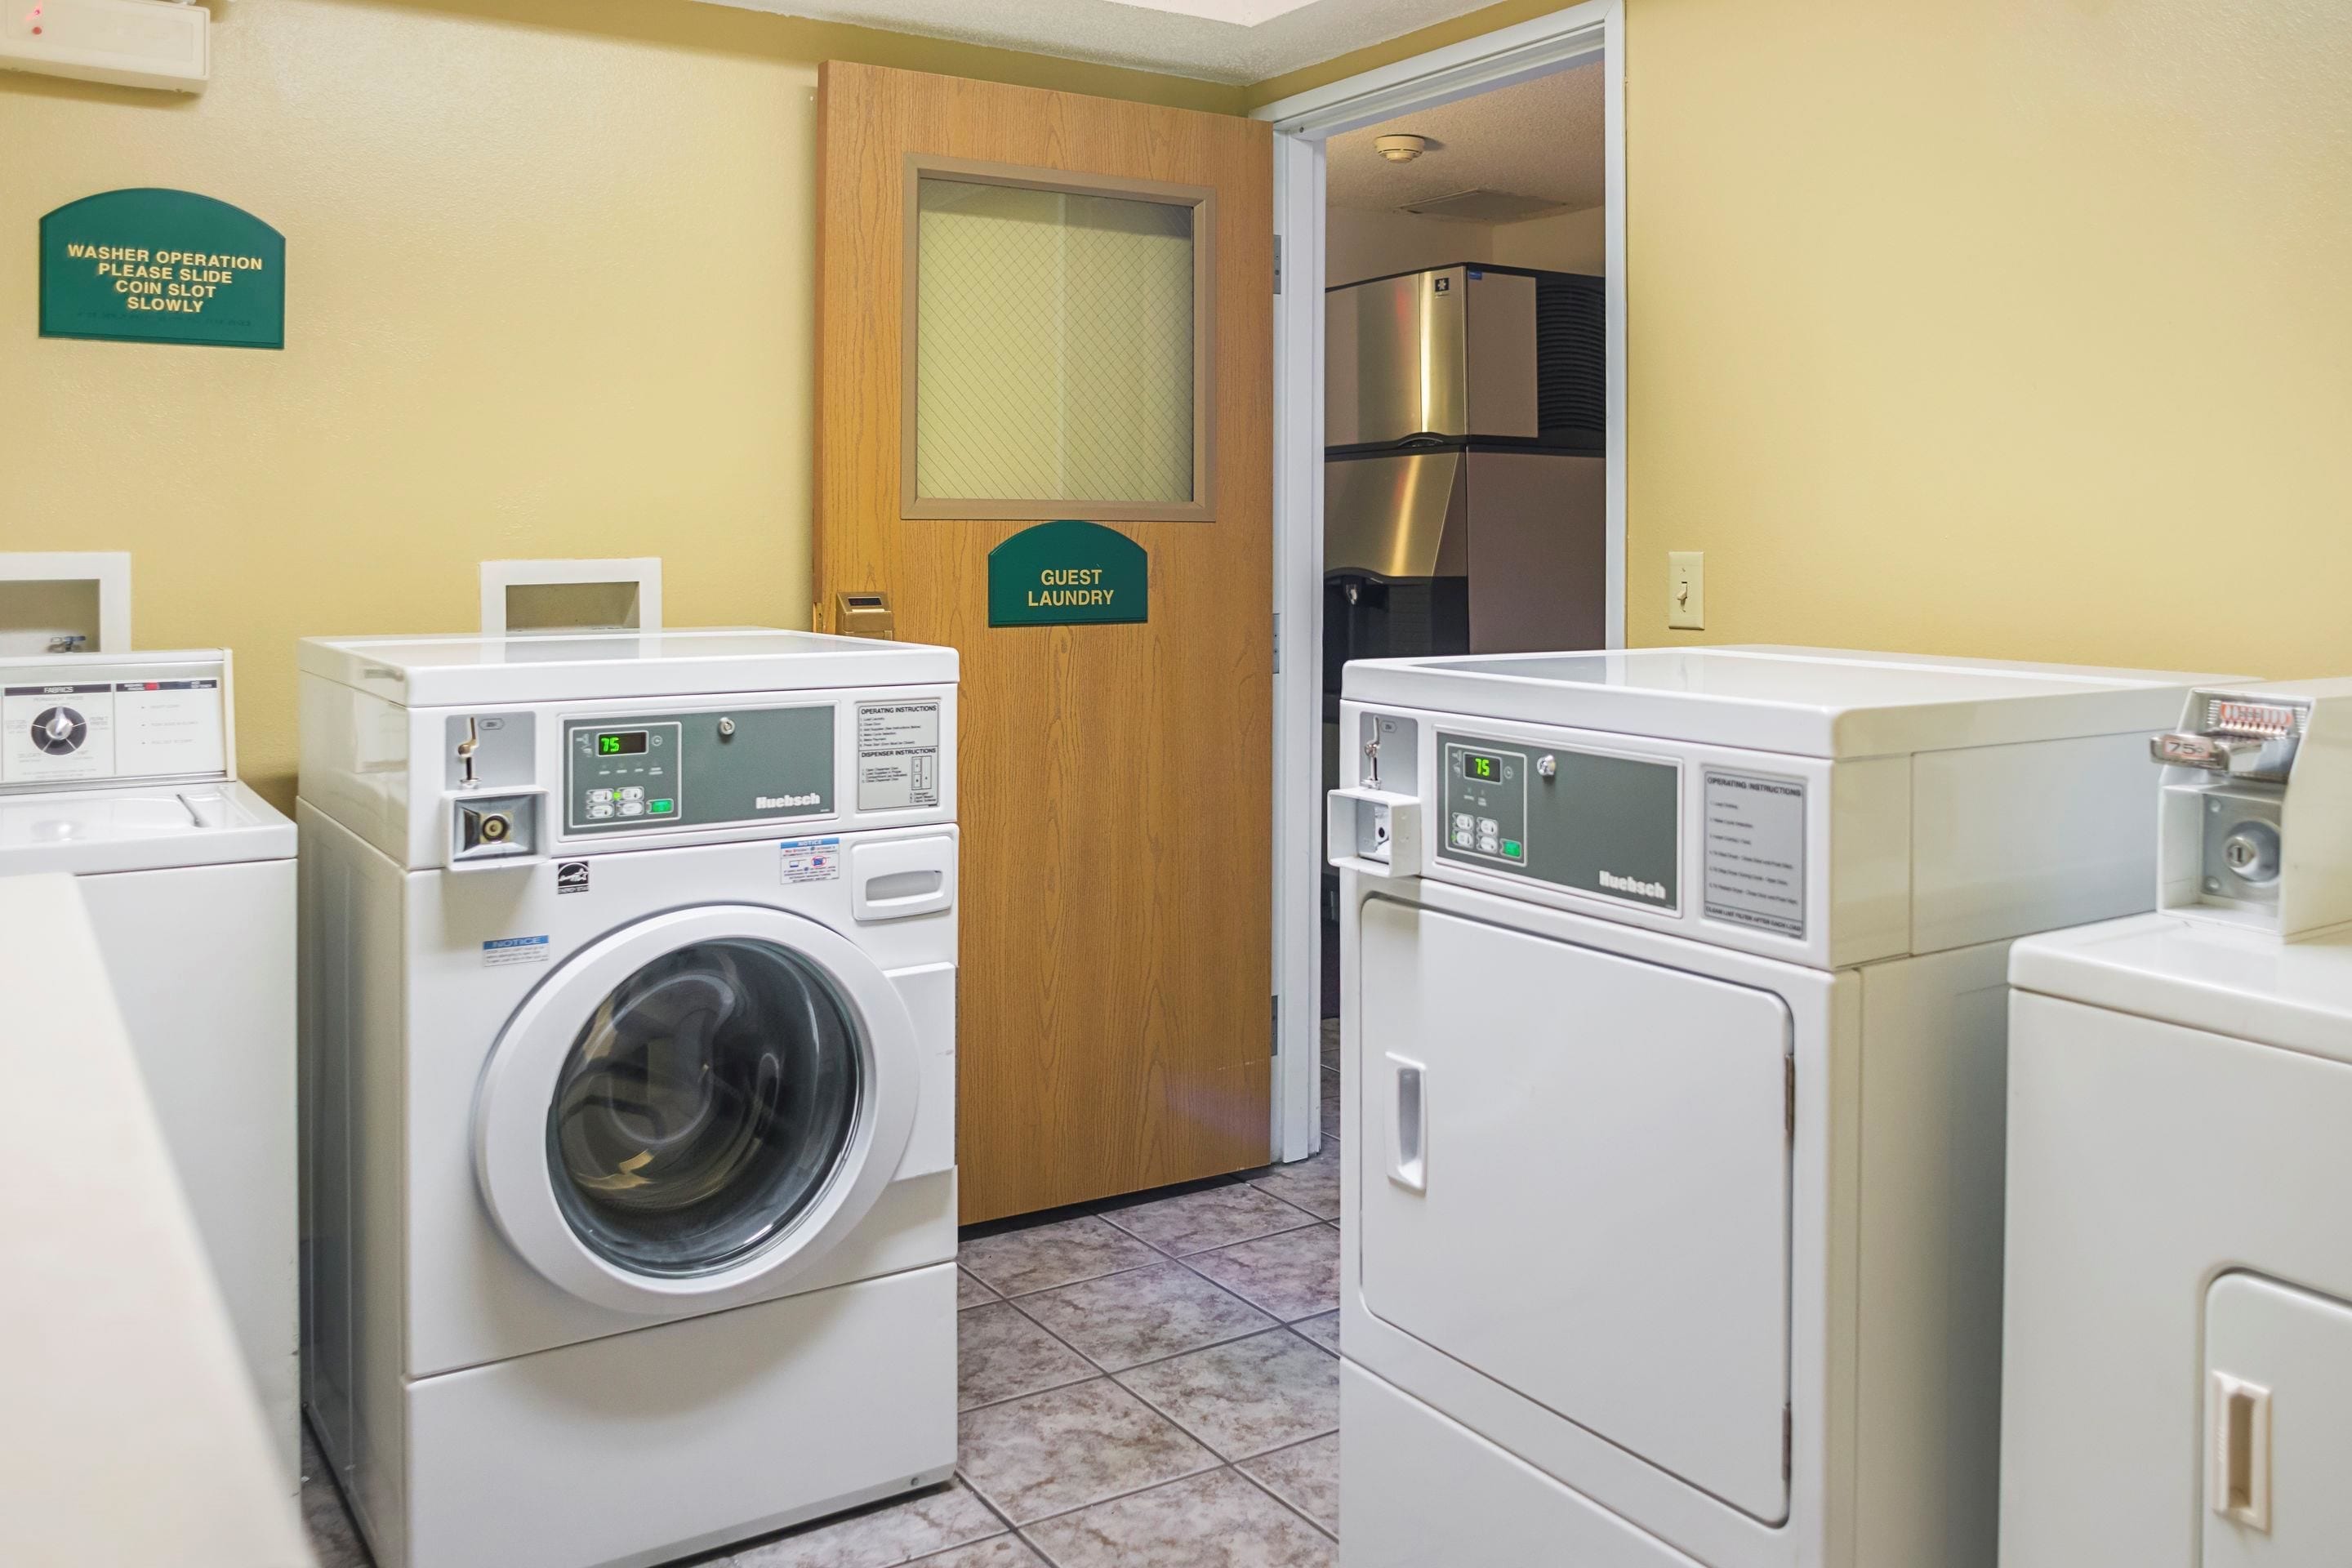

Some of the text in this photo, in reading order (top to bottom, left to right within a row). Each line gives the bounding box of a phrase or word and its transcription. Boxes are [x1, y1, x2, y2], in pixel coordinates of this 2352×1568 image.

[68, 244, 262, 270] WASHER OPERATION
[98, 262, 233, 284] PLEASE SLIDE
[115, 280, 216, 298] COIN SLOT
[127, 296, 203, 313] SLOWLY
[1040, 569, 1102, 586] GUEST
[1027, 590, 1115, 607] LAUNDRY
[895, 705, 937, 713] INSTRUCTIONS
[601, 737, 620, 752] 75
[1475, 758, 1490, 777] 75
[1707, 777, 1802, 797] OPERATING INSTRUCTIONS
[755, 792, 821, 809] Huebsch
[1599, 870, 1666, 900] Huebsch
[492, 938, 542, 948] NOTICE
